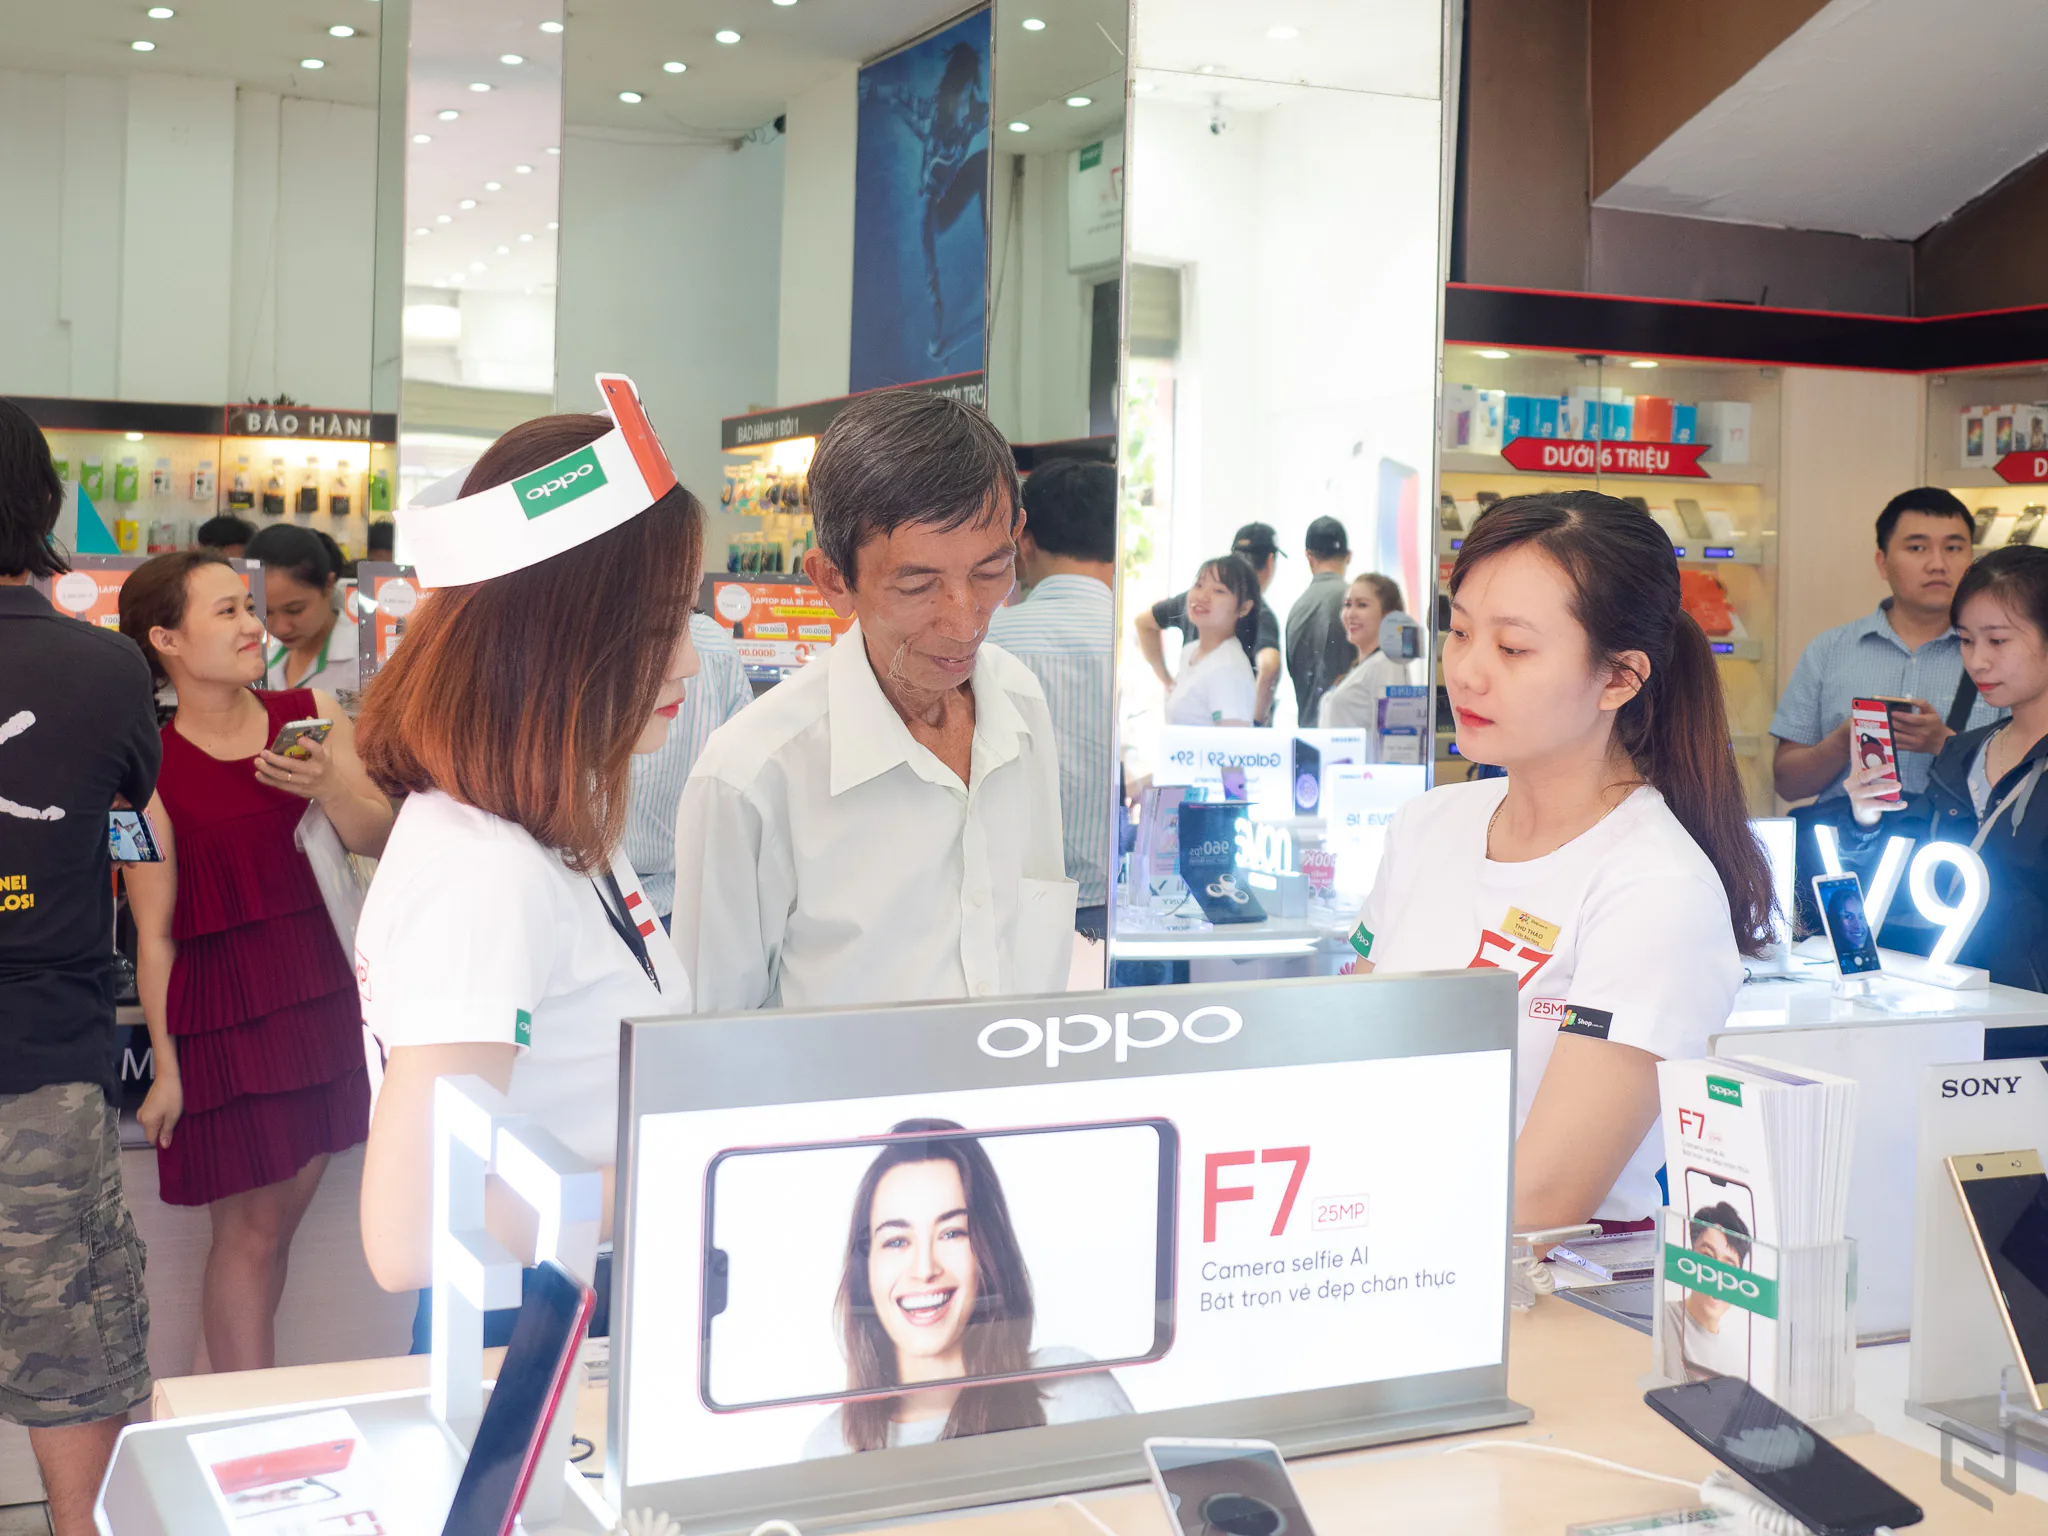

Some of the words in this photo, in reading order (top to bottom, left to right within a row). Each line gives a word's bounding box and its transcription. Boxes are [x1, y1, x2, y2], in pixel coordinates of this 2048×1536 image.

[246, 409, 299, 433] BẢO
[1543, 445, 1594, 467] DƯỚI
[1601, 449, 1612, 467] 6
[1616, 447, 1669, 474] TRIỆU
[526, 463, 594, 500] oppo
[752, 596, 779, 605] LAPTOP
[738, 648, 776, 658] 00.000Đ
[1533, 1001, 1567, 1017] 25M
[977, 1005, 1244, 1068] oppo
[1709, 1083, 1740, 1099] oppo
[1941, 1075, 2022, 1100] SONY
[1678, 1107, 1706, 1140] F7
[1203, 1145, 1311, 1243] F7
[1317, 1202, 1365, 1223] 25MP
[1201, 1259, 1285, 1281] Camera
[1292, 1249, 1344, 1272] selfie
[1350, 1246, 1369, 1266] AI
[1676, 1256, 1760, 1299] oppo
[1242, 1288, 1282, 1308] trọn
[1317, 1279, 1355, 1302] đẹp
